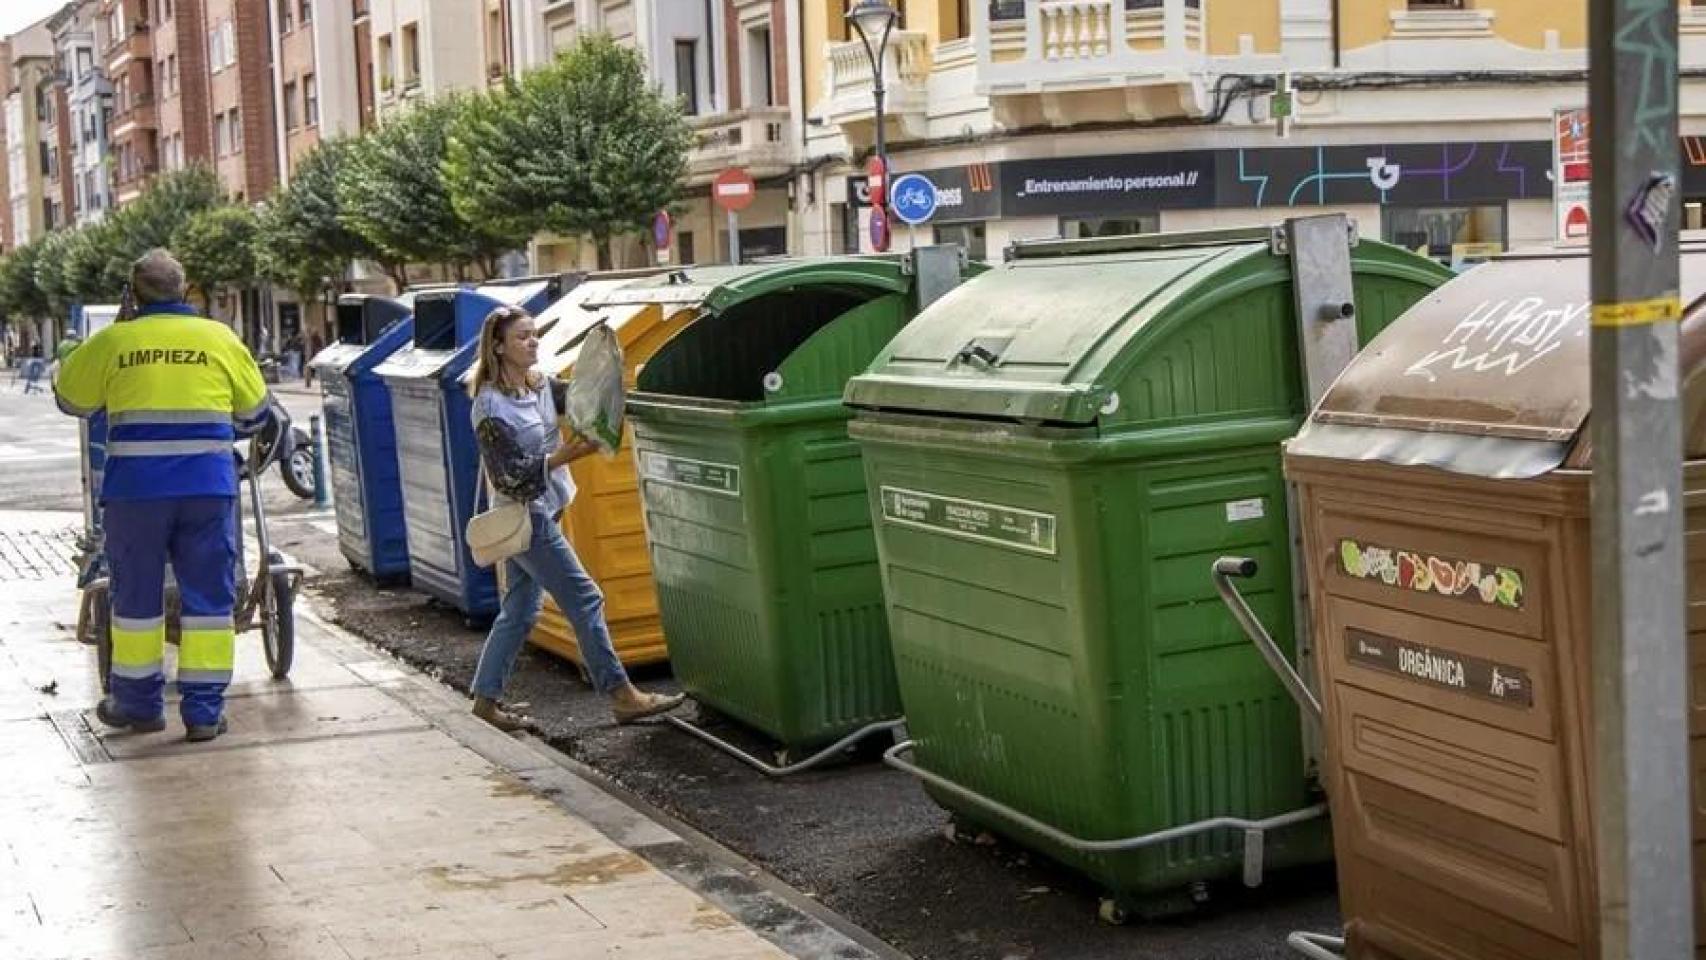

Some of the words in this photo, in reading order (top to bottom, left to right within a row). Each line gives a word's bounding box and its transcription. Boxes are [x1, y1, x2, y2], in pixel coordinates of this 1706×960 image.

[1124, 171, 1185, 192] personal
[118, 348, 208, 369] LIMPIEZA
[1398, 646, 1466, 687] ORGÁNICA
